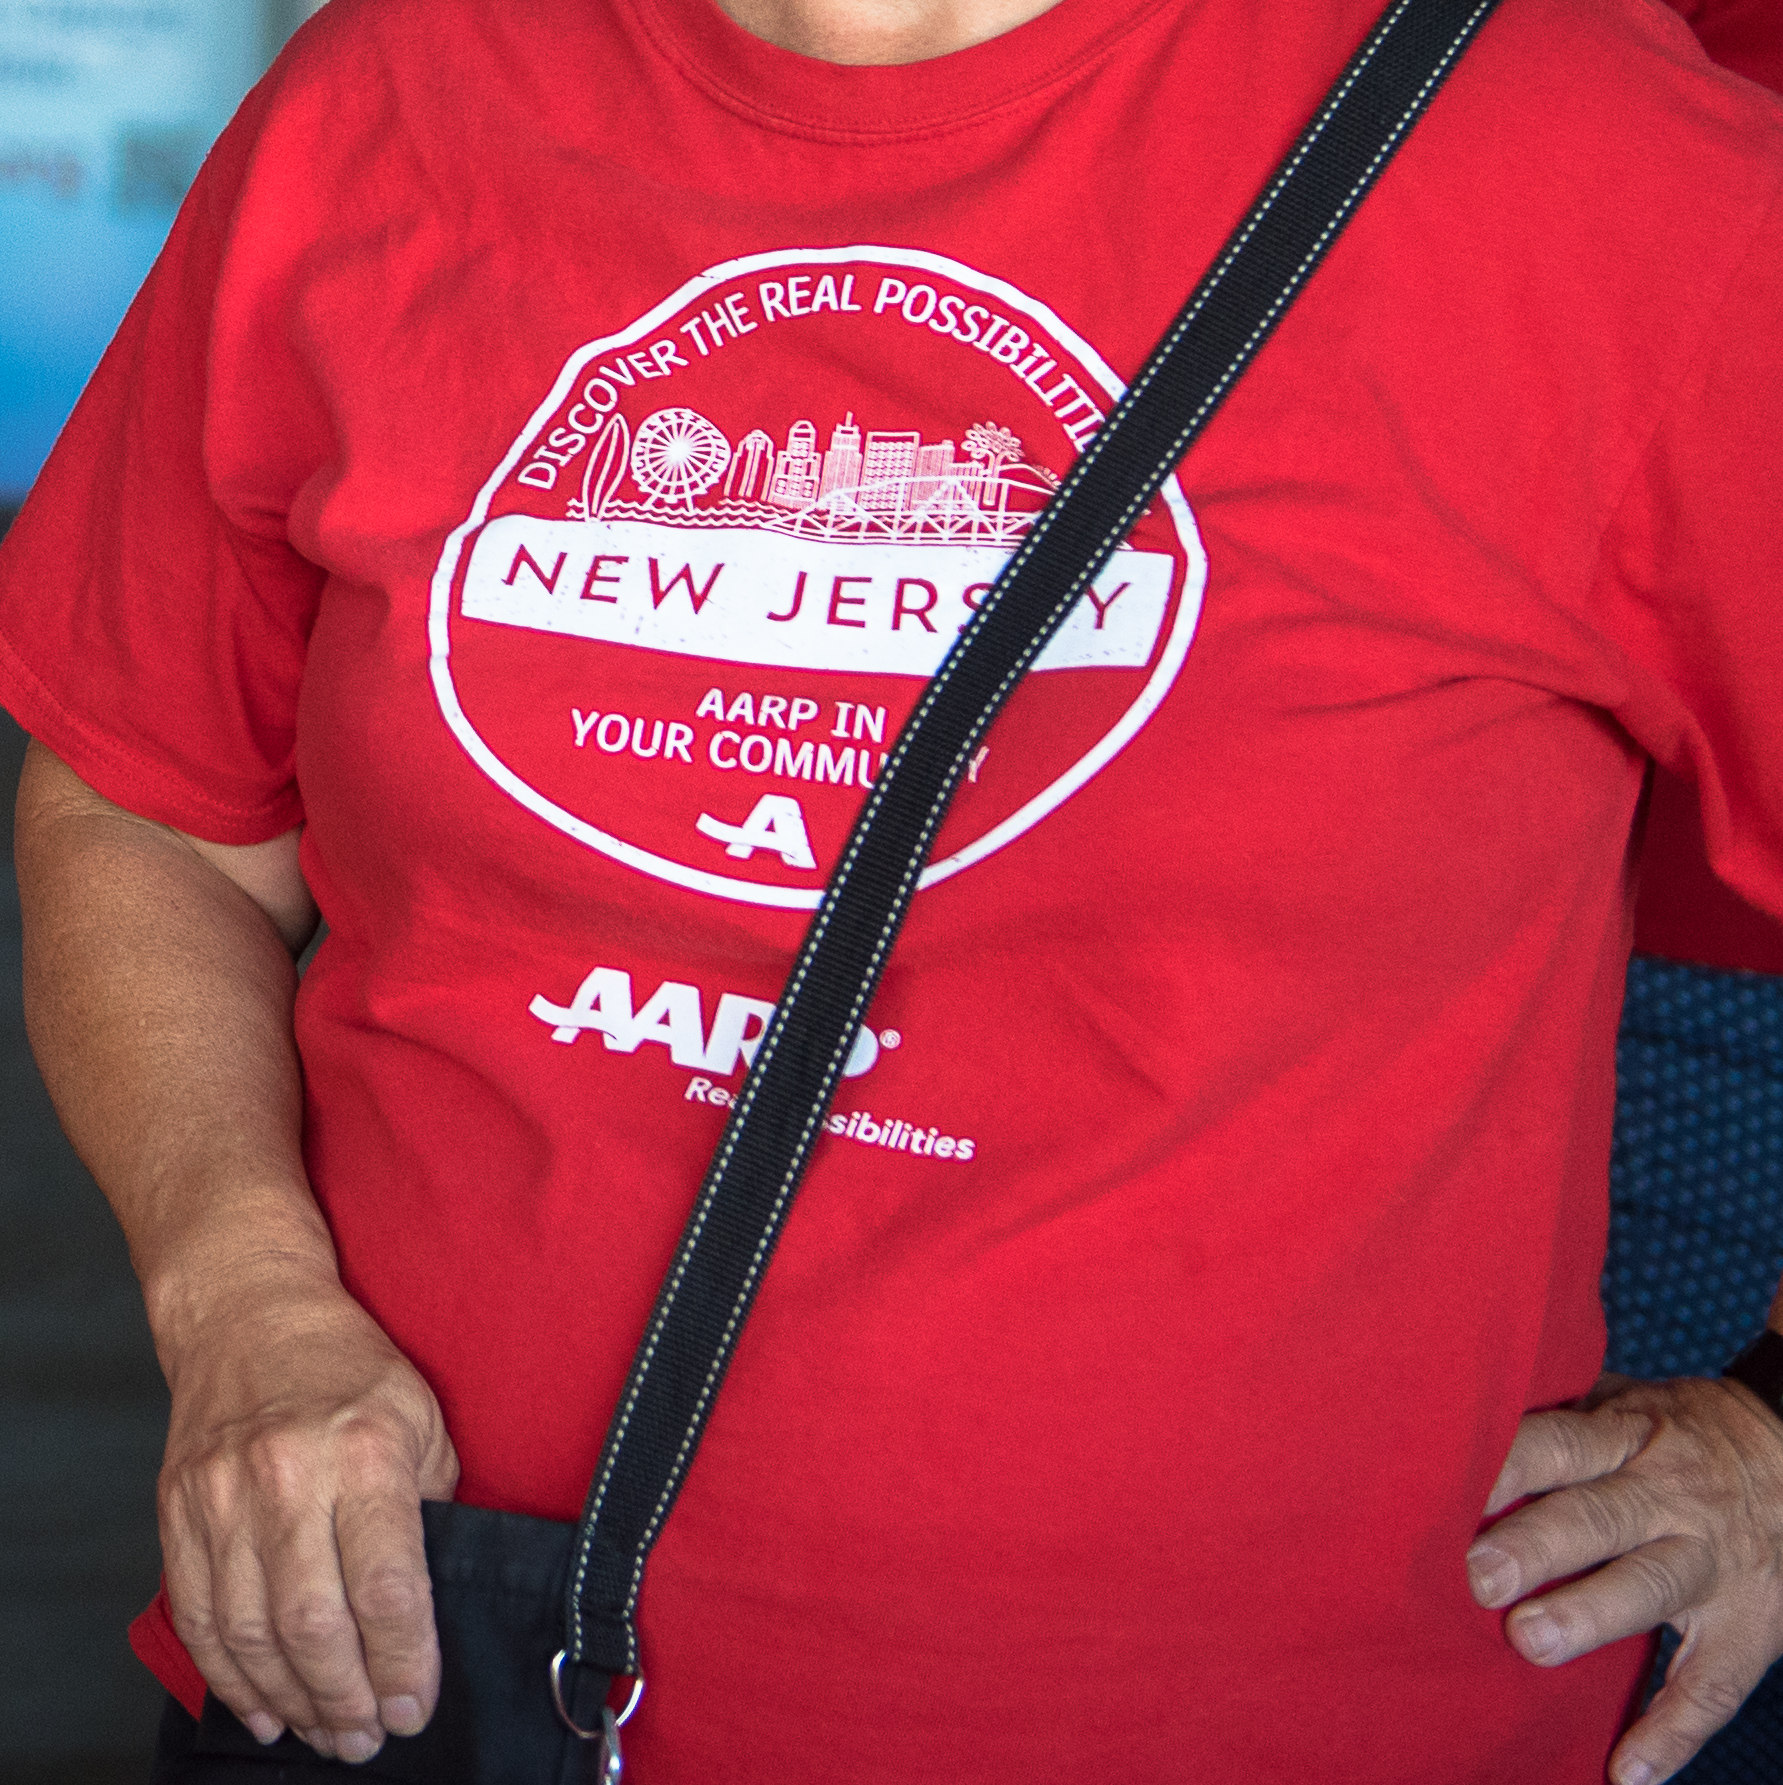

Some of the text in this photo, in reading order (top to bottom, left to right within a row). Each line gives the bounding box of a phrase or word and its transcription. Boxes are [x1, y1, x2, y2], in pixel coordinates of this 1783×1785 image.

[517, 337, 688, 490] DISCOVER
[681, 292, 759, 357] THE
[759, 273, 862, 321] REAL
[501, 543, 725, 616] NEW
[571, 708, 694, 763] YOUR
[695, 687, 886, 743] AARP IN
